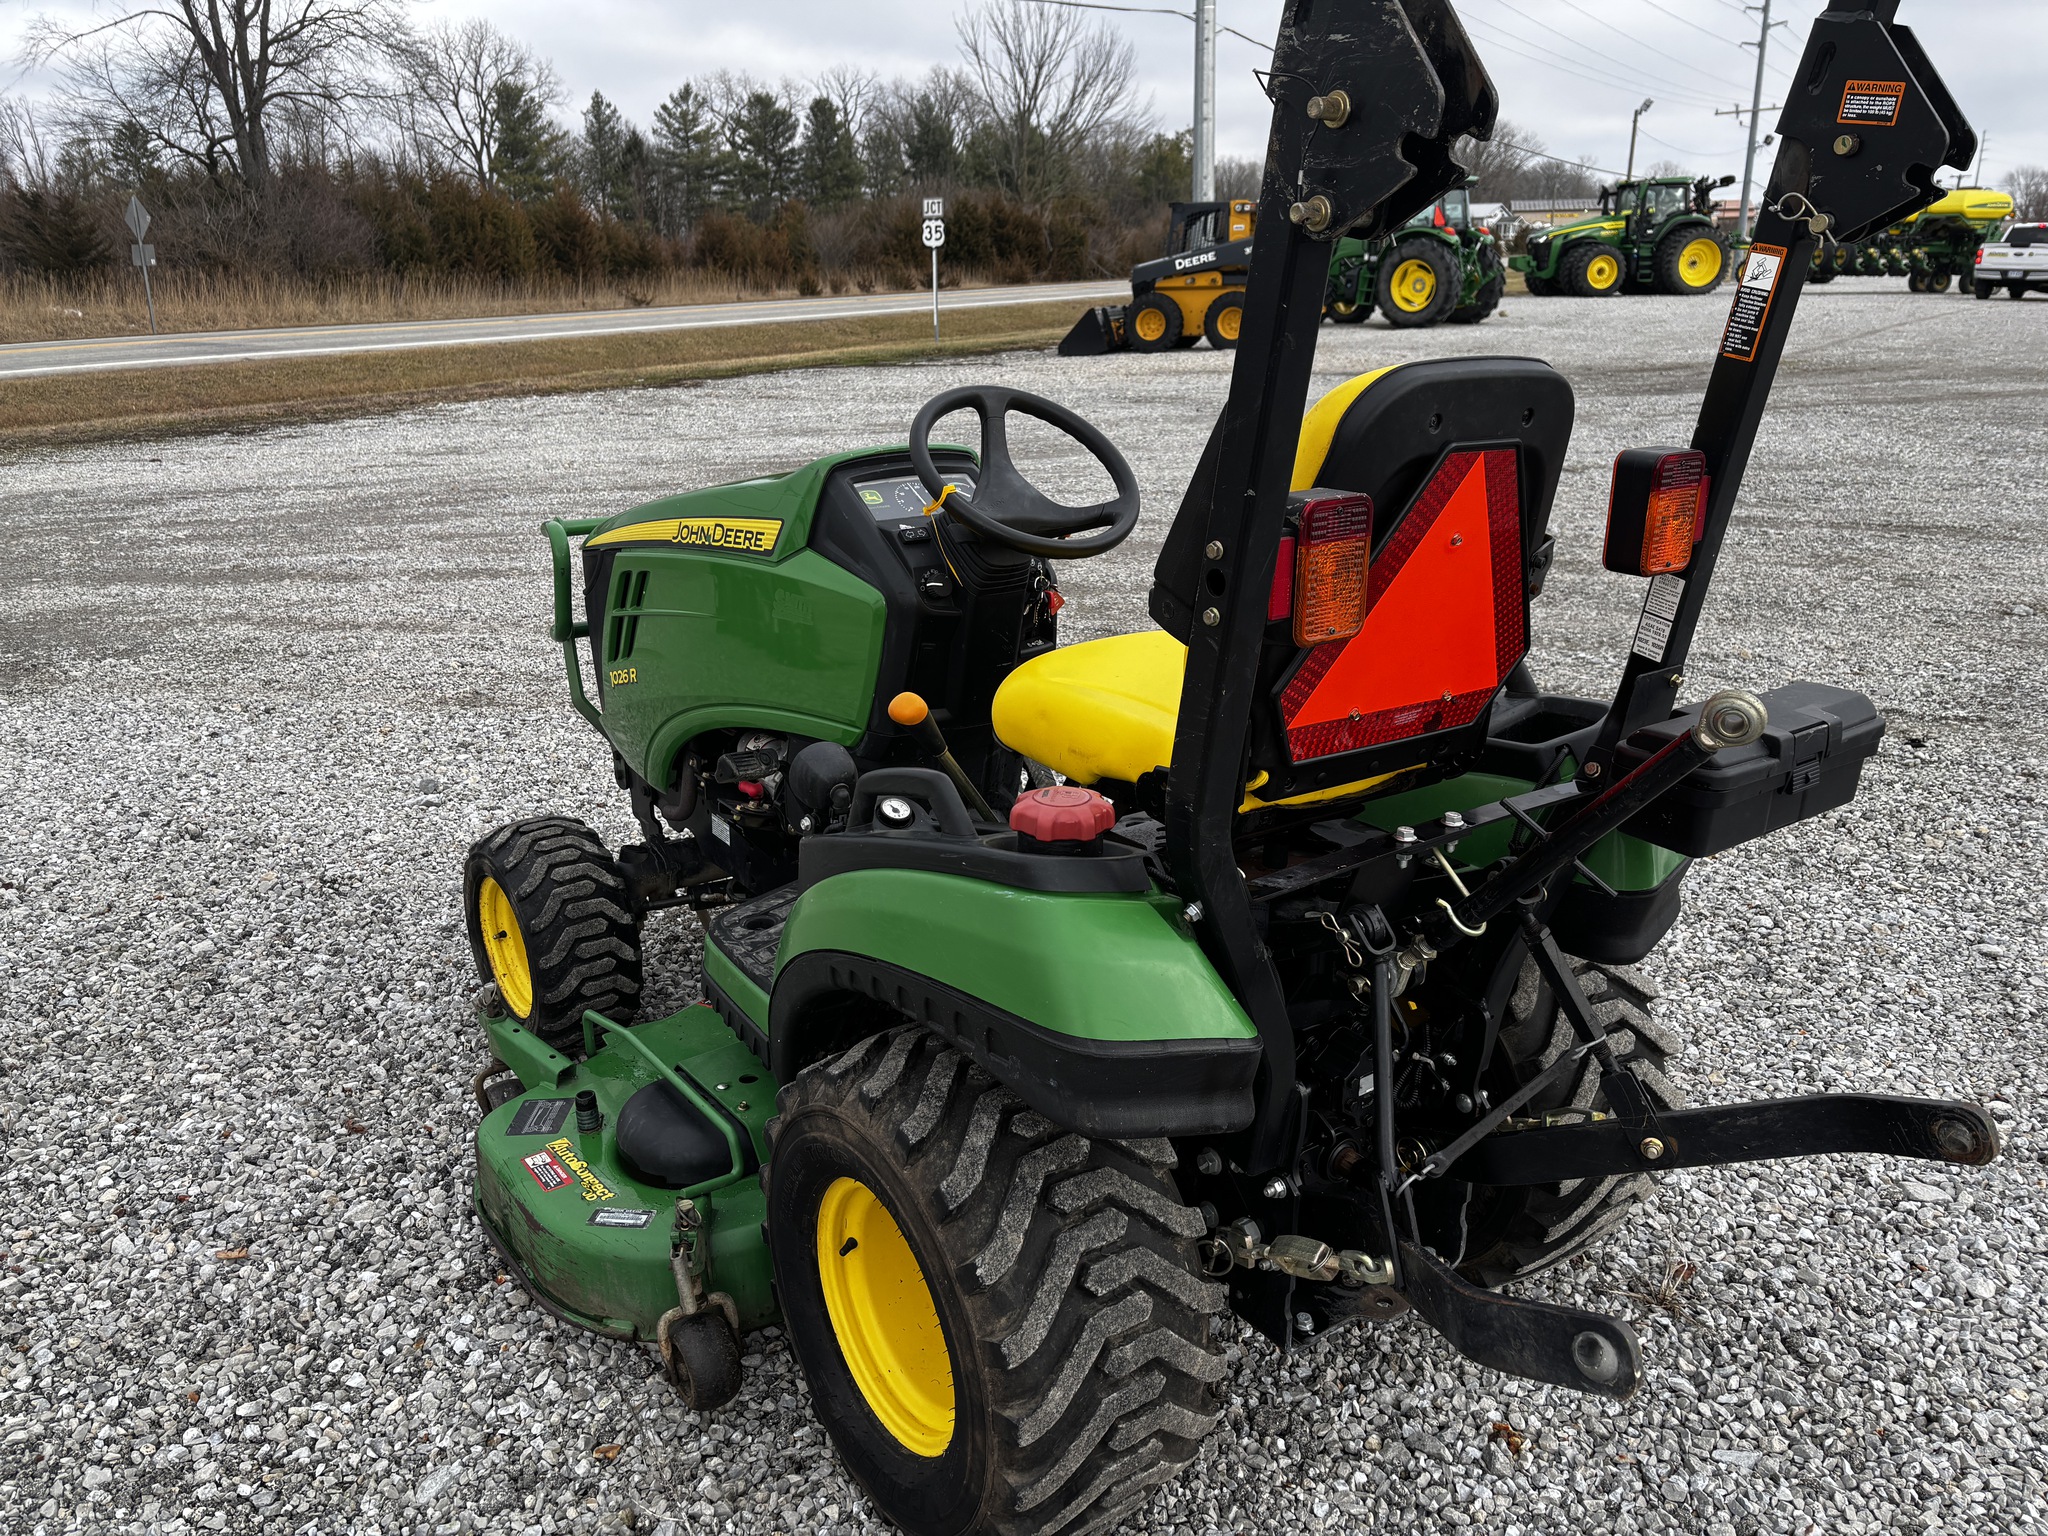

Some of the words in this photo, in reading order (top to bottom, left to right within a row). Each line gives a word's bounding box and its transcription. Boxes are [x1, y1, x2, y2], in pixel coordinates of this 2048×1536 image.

[1857, 83, 1902, 93] WARNING
[925, 201, 942, 214] JCT
[924, 225, 943, 241] 35
[1759, 245, 1784, 255] WARNING
[1174, 251, 1217, 271] DEERE
[672, 521, 711, 544] JOHN
[712, 523, 765, 549] DEERE
[1644, 614, 1670, 628] CERTIFICATION
